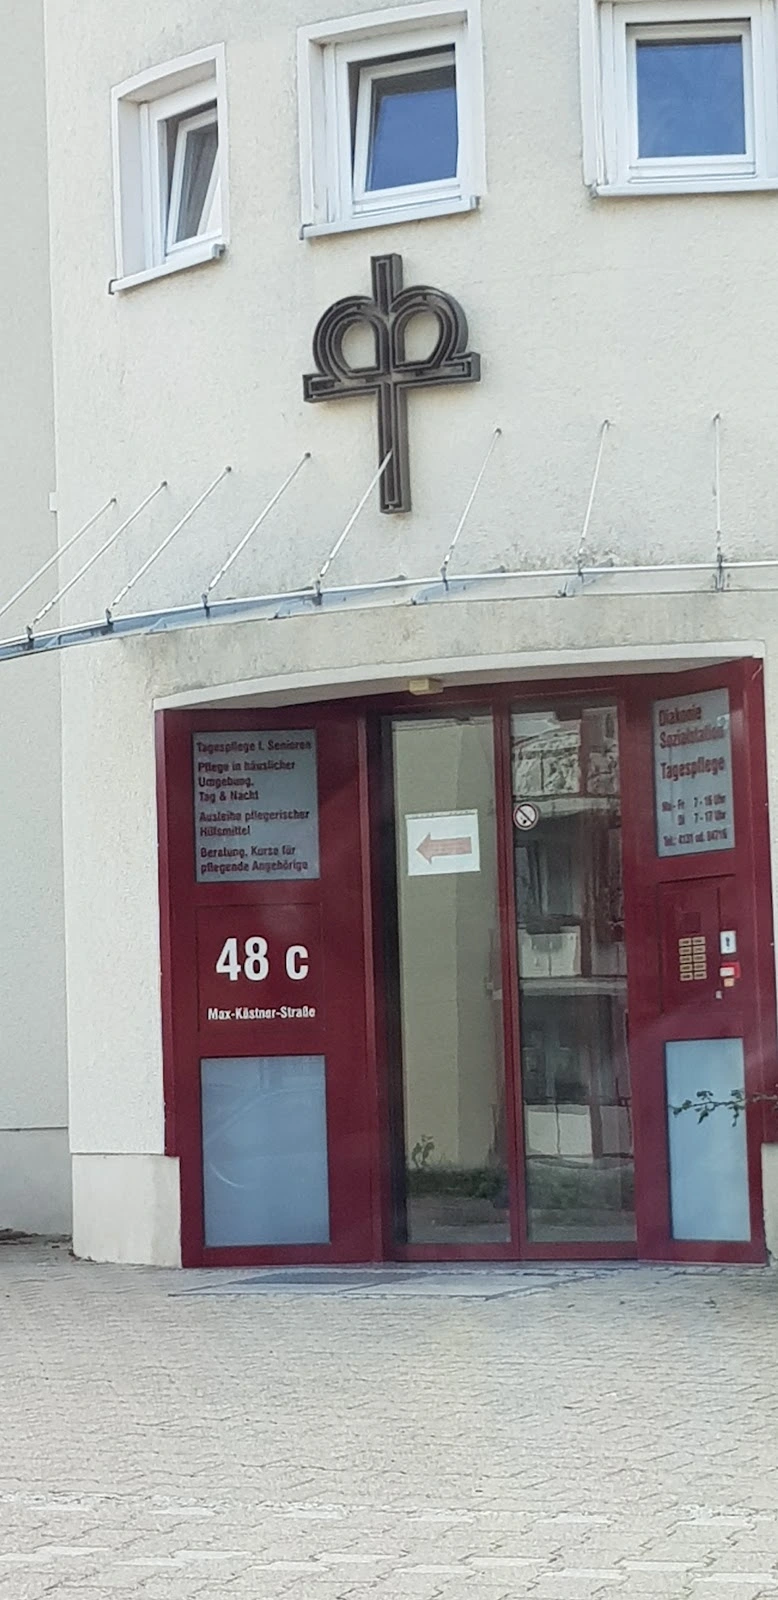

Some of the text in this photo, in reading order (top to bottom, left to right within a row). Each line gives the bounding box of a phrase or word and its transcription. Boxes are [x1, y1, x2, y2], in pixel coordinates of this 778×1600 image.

[659, 704, 702, 726] Diakonie
[659, 723, 725, 749] Sozialstation
[196, 741, 255, 755] Tagespflege
[267, 739, 311, 751] Senioren
[197, 759, 295, 774] Pflege in häuslicher
[660, 756, 725, 782] Tagespflege
[199, 790, 259, 803] Tag & Nacht
[199, 809, 310, 823] Ausleihe pflegerischer
[200, 825, 251, 837] Hilfsmittel
[251, 845, 279, 856] Kurse
[282, 844, 296, 856] für
[200, 859, 308, 875] pflegende Angehörige
[216, 936, 309, 981] 48 c
